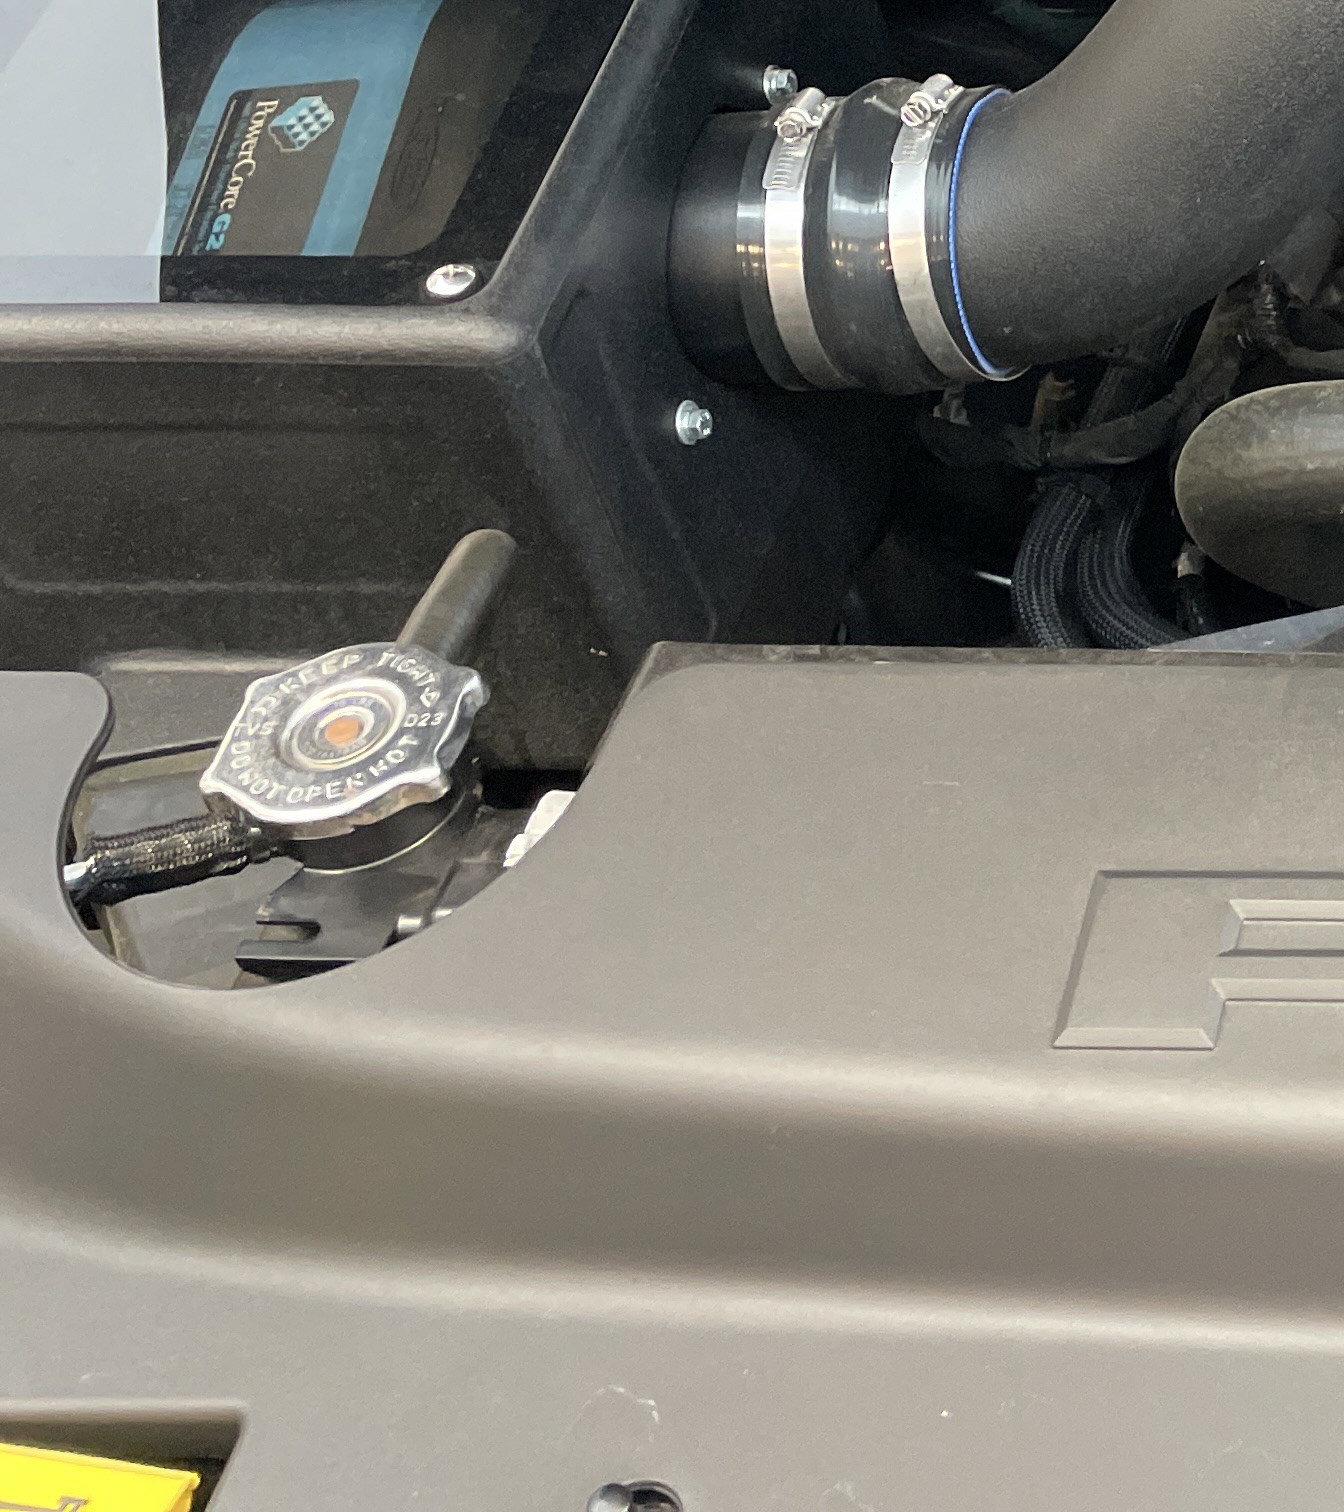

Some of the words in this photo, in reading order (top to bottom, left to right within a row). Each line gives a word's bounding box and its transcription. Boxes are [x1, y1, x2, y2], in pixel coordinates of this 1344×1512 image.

[219, 98, 280, 212] PowerCore
[205, 212, 233, 251] G2
[278, 653, 366, 694] KEEP
